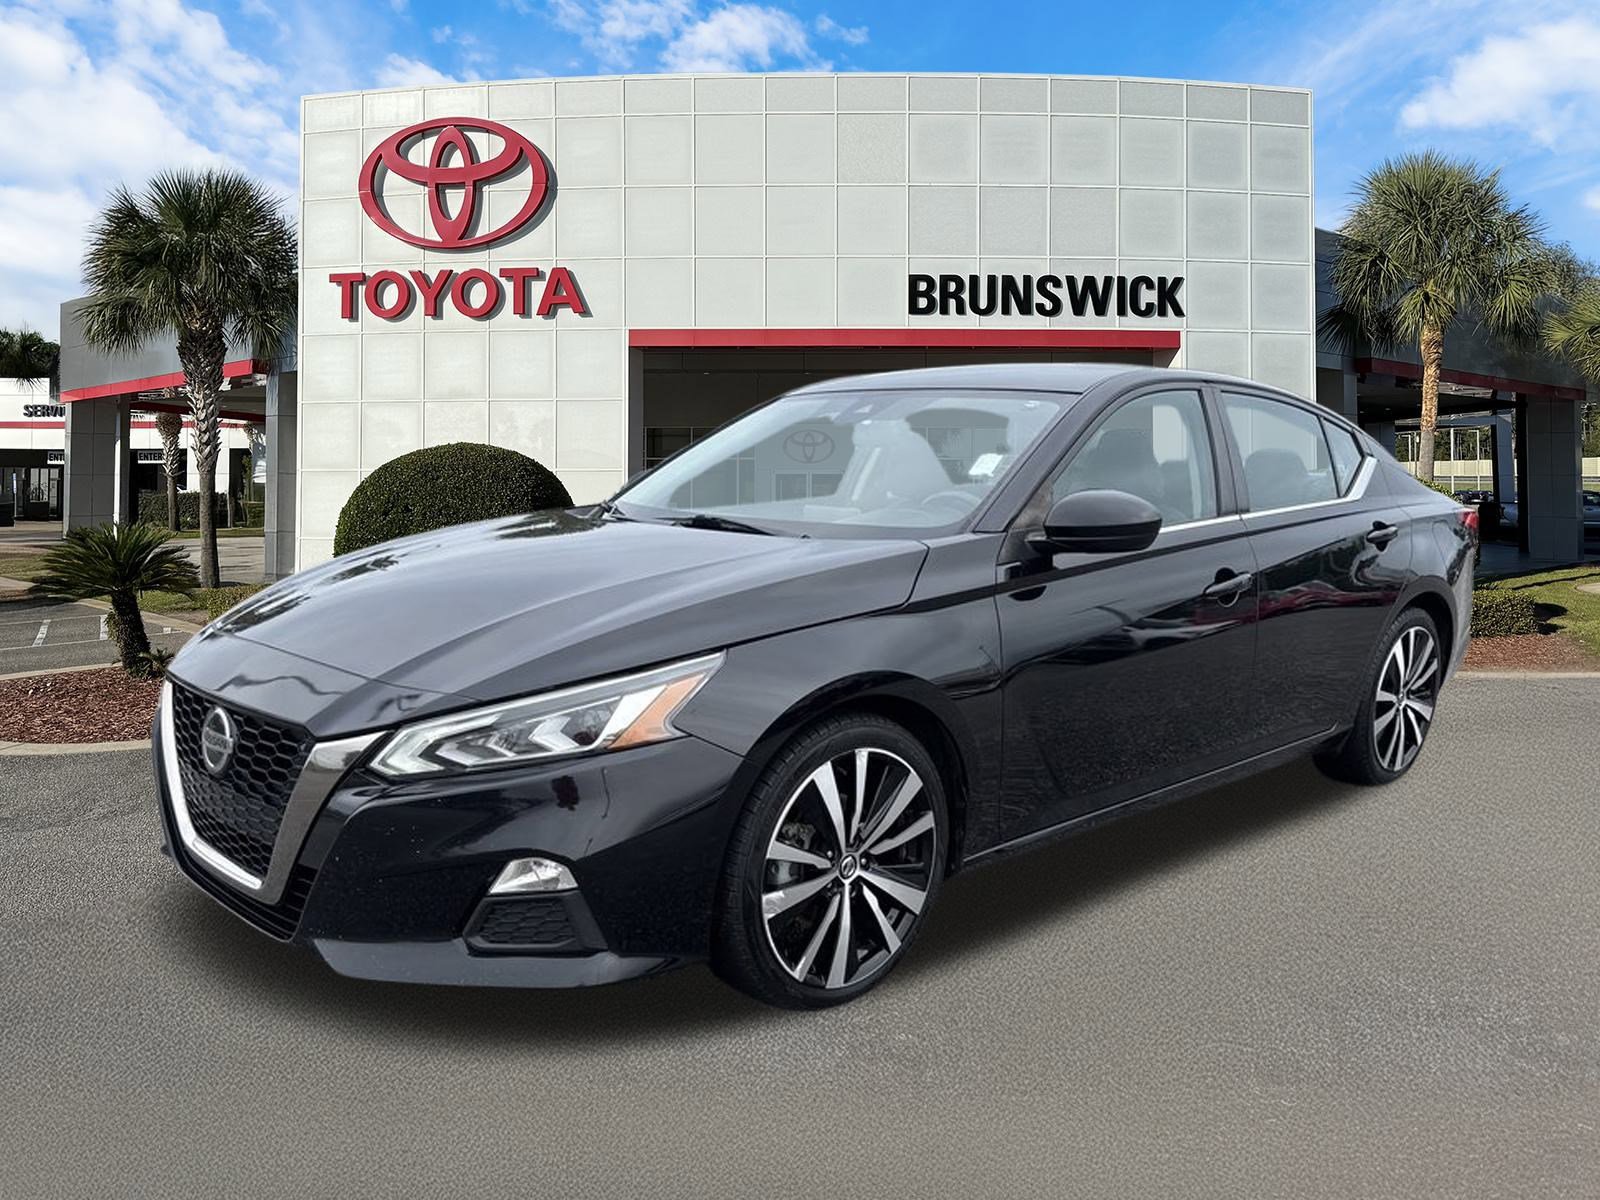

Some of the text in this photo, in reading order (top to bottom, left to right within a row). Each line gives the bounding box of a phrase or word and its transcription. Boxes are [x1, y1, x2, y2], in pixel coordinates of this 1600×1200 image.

[329, 267, 589, 320] TOYOTA
[908, 274, 1185, 318] BRUNSWICK
[23, 404, 66, 418] SERVI
[48, 453, 65, 462] ENT
[138, 452, 163, 461] ENTER
